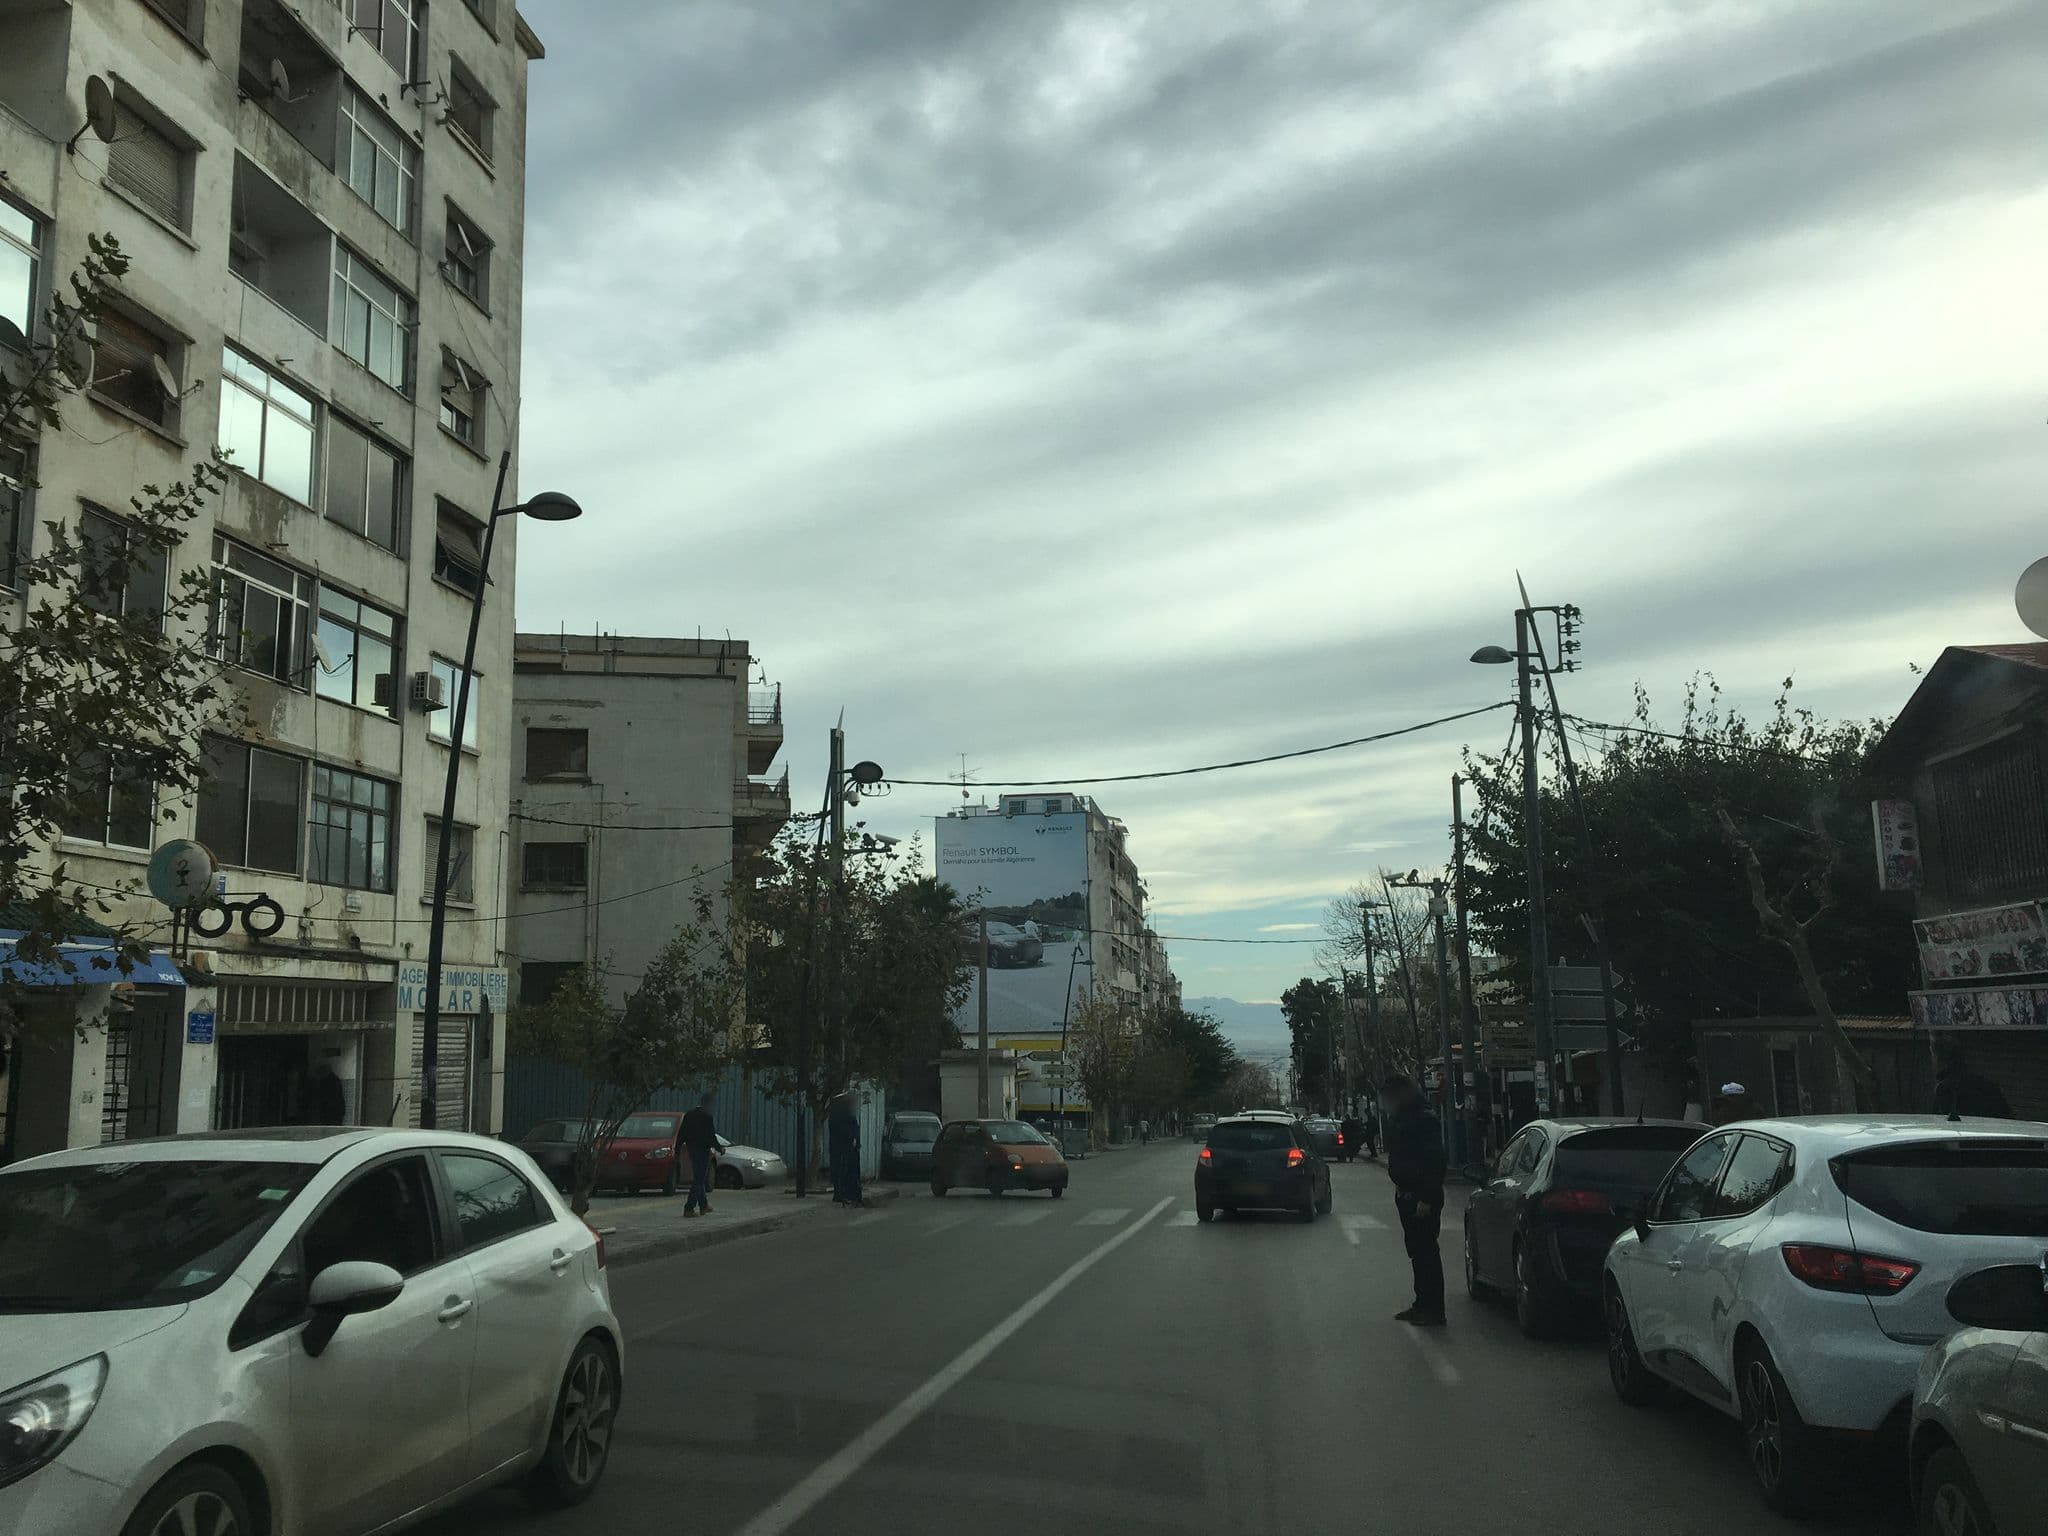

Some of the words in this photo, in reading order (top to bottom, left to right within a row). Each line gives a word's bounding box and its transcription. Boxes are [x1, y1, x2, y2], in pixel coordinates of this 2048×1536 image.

[943, 848, 976, 857] Renault
[979, 846, 1020, 856] SYMBOL
[400, 967, 443, 985] AGENE
[399, 986, 473, 1011] MOAR
